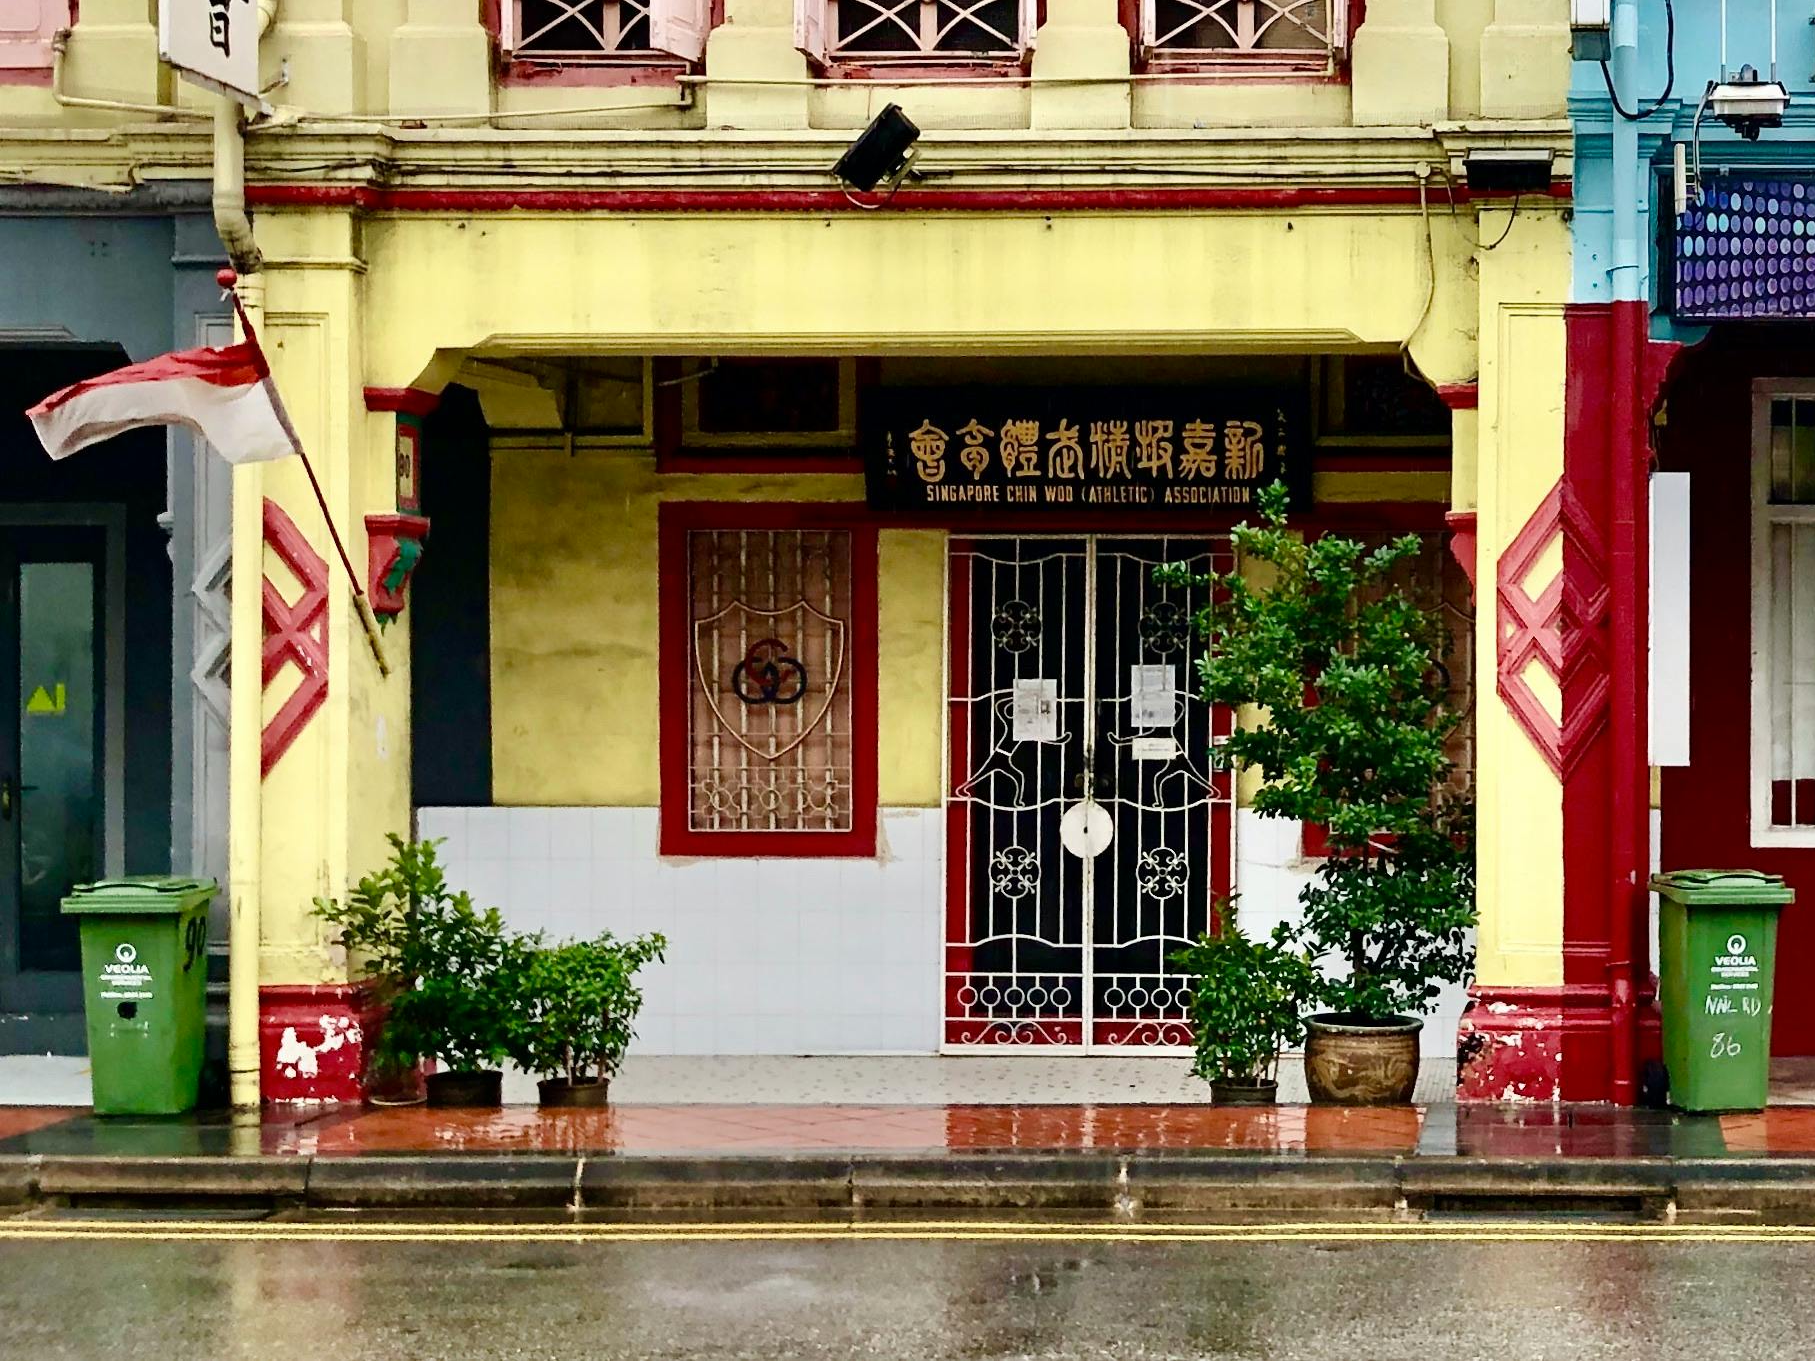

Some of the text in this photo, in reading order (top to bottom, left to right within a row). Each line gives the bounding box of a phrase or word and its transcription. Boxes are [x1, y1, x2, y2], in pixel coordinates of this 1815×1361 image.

[927, 485, 1250, 503] SINGAPORE CHIN WOO (ATHLETIC) ASSOCIATION
[1715, 956, 1756, 966] VEOLIA
[104, 964, 150, 974] VEOLIA
[1710, 1032, 1741, 1058] 86
